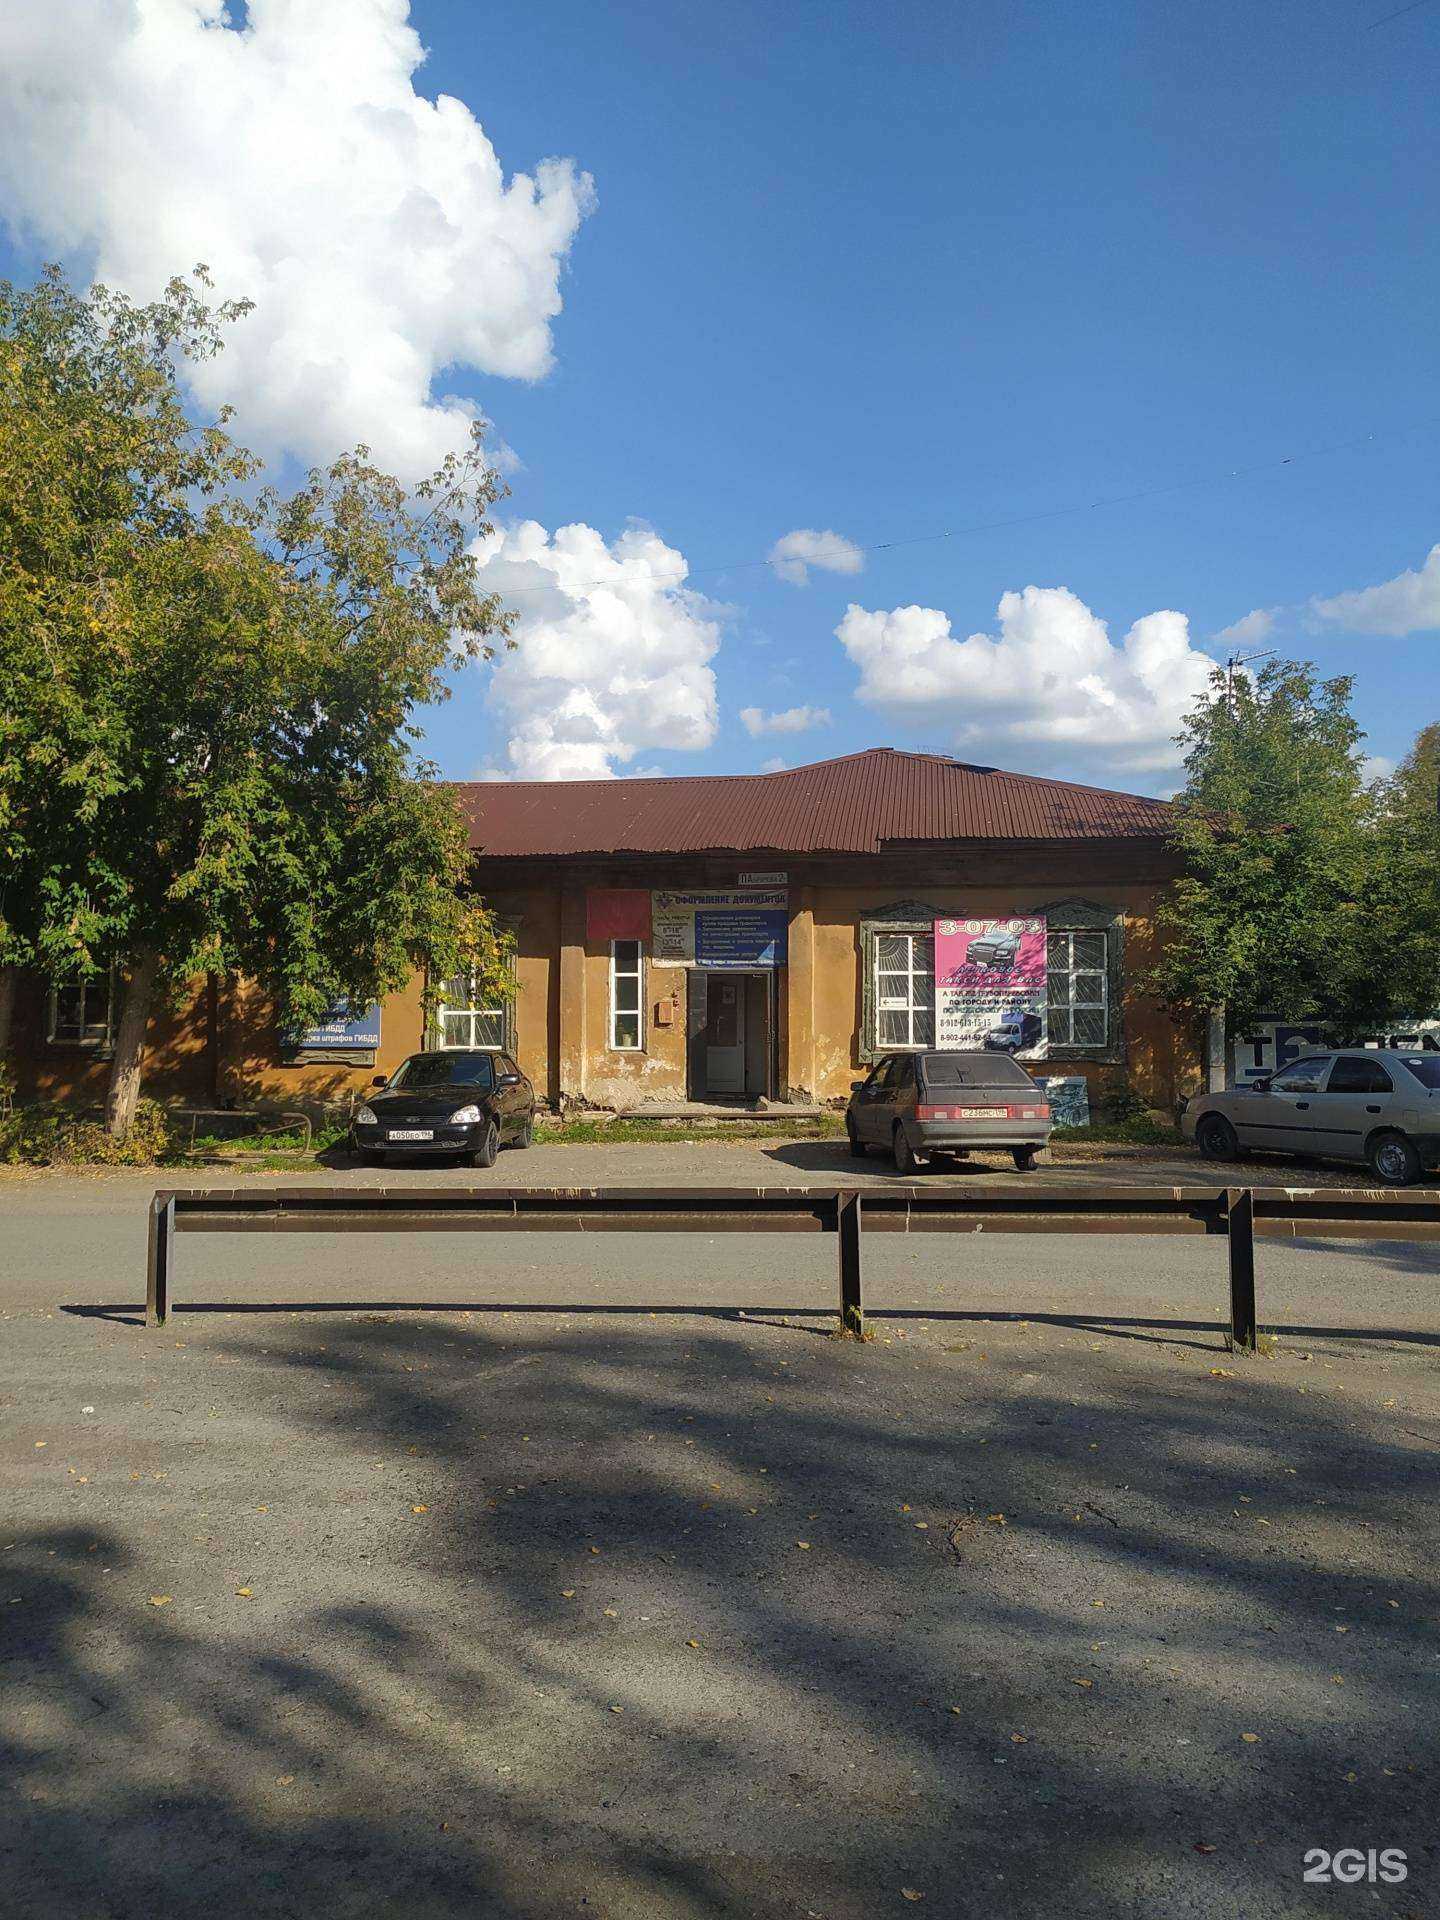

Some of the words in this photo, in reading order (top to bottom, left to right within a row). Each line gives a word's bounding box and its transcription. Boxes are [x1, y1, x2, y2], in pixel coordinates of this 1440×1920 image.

[938, 918, 1042, 936] 3-07-03
[321, 1034, 353, 1043] штрафов
[354, 1034, 378, 1043] ГИБДД
